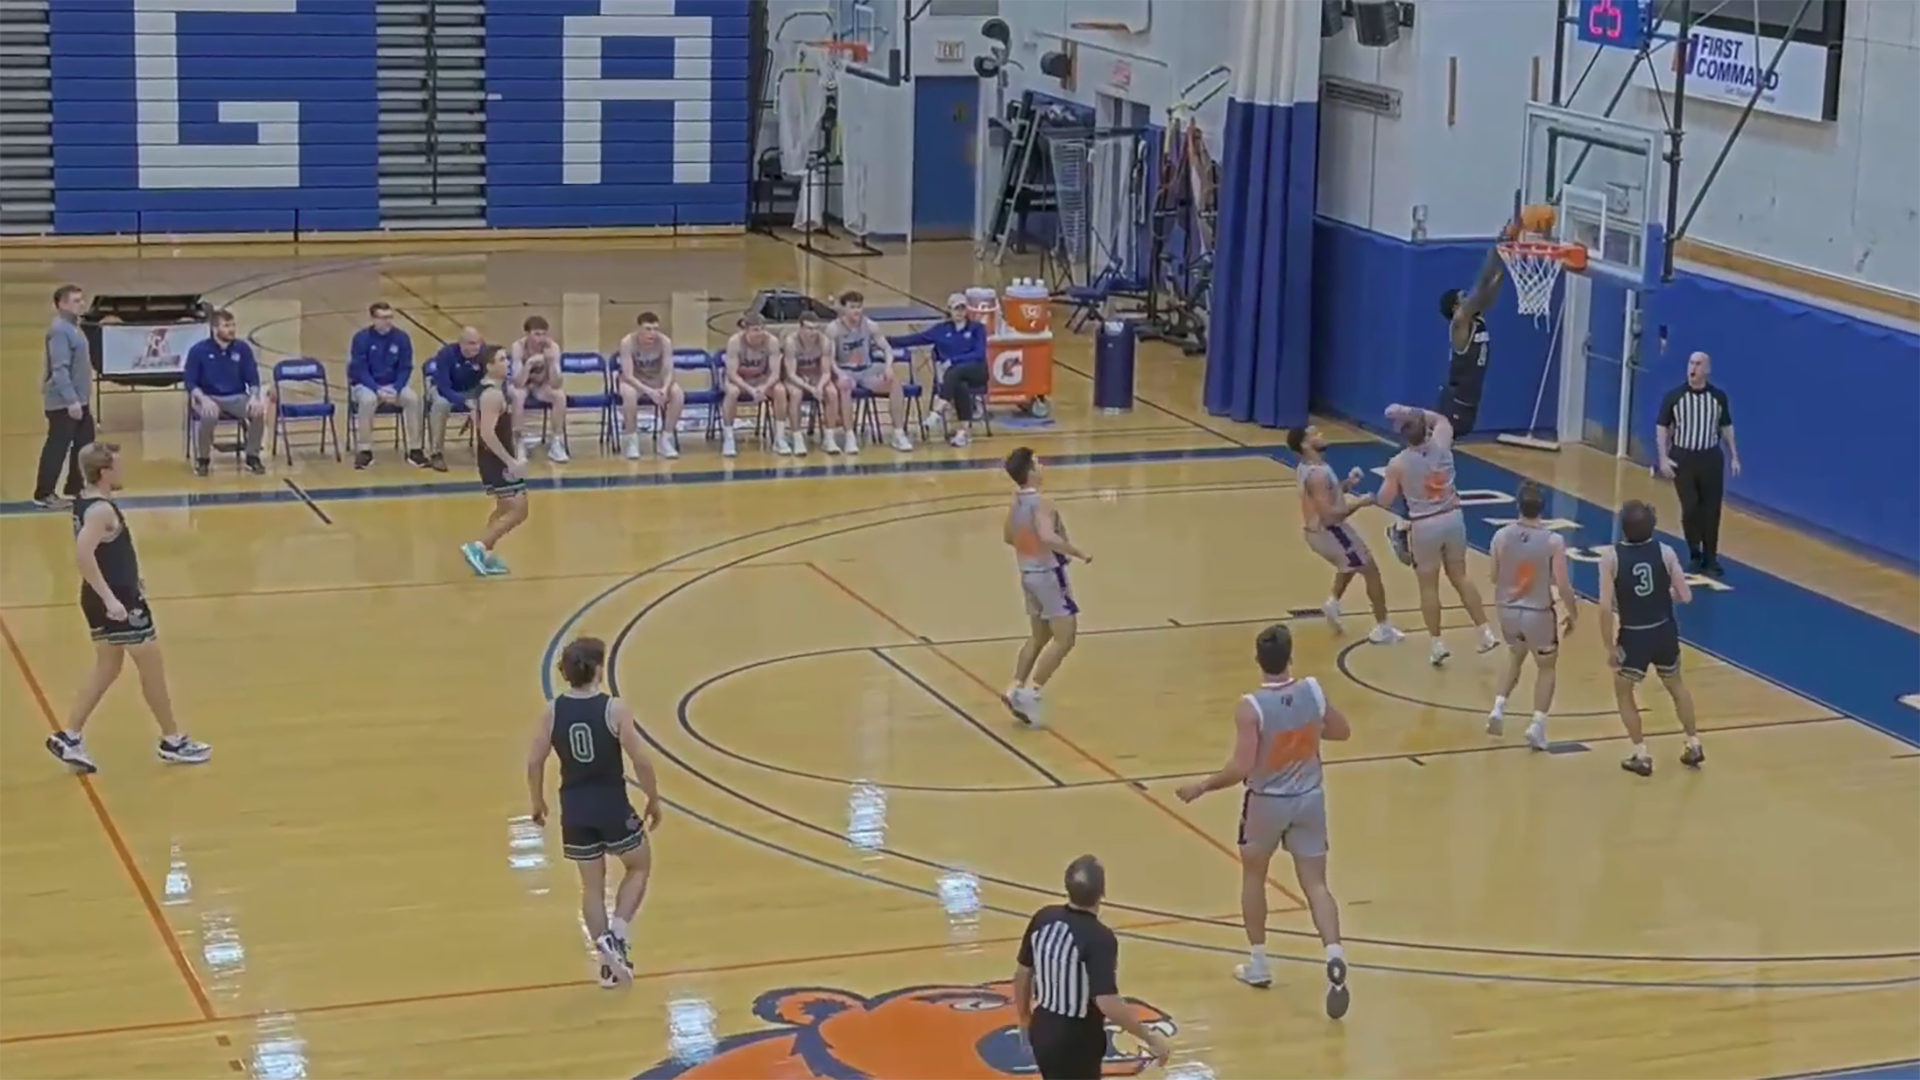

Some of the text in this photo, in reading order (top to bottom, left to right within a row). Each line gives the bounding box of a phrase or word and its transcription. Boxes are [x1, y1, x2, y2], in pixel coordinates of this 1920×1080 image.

[1700, 34, 1743, 60] FIRST
[1696, 57, 1779, 91] COMMAD
[562, 0, 712, 184] A
[993, 349, 1023, 385] G
[1631, 562, 1655, 597] 3
[568, 722, 595, 764] 0
